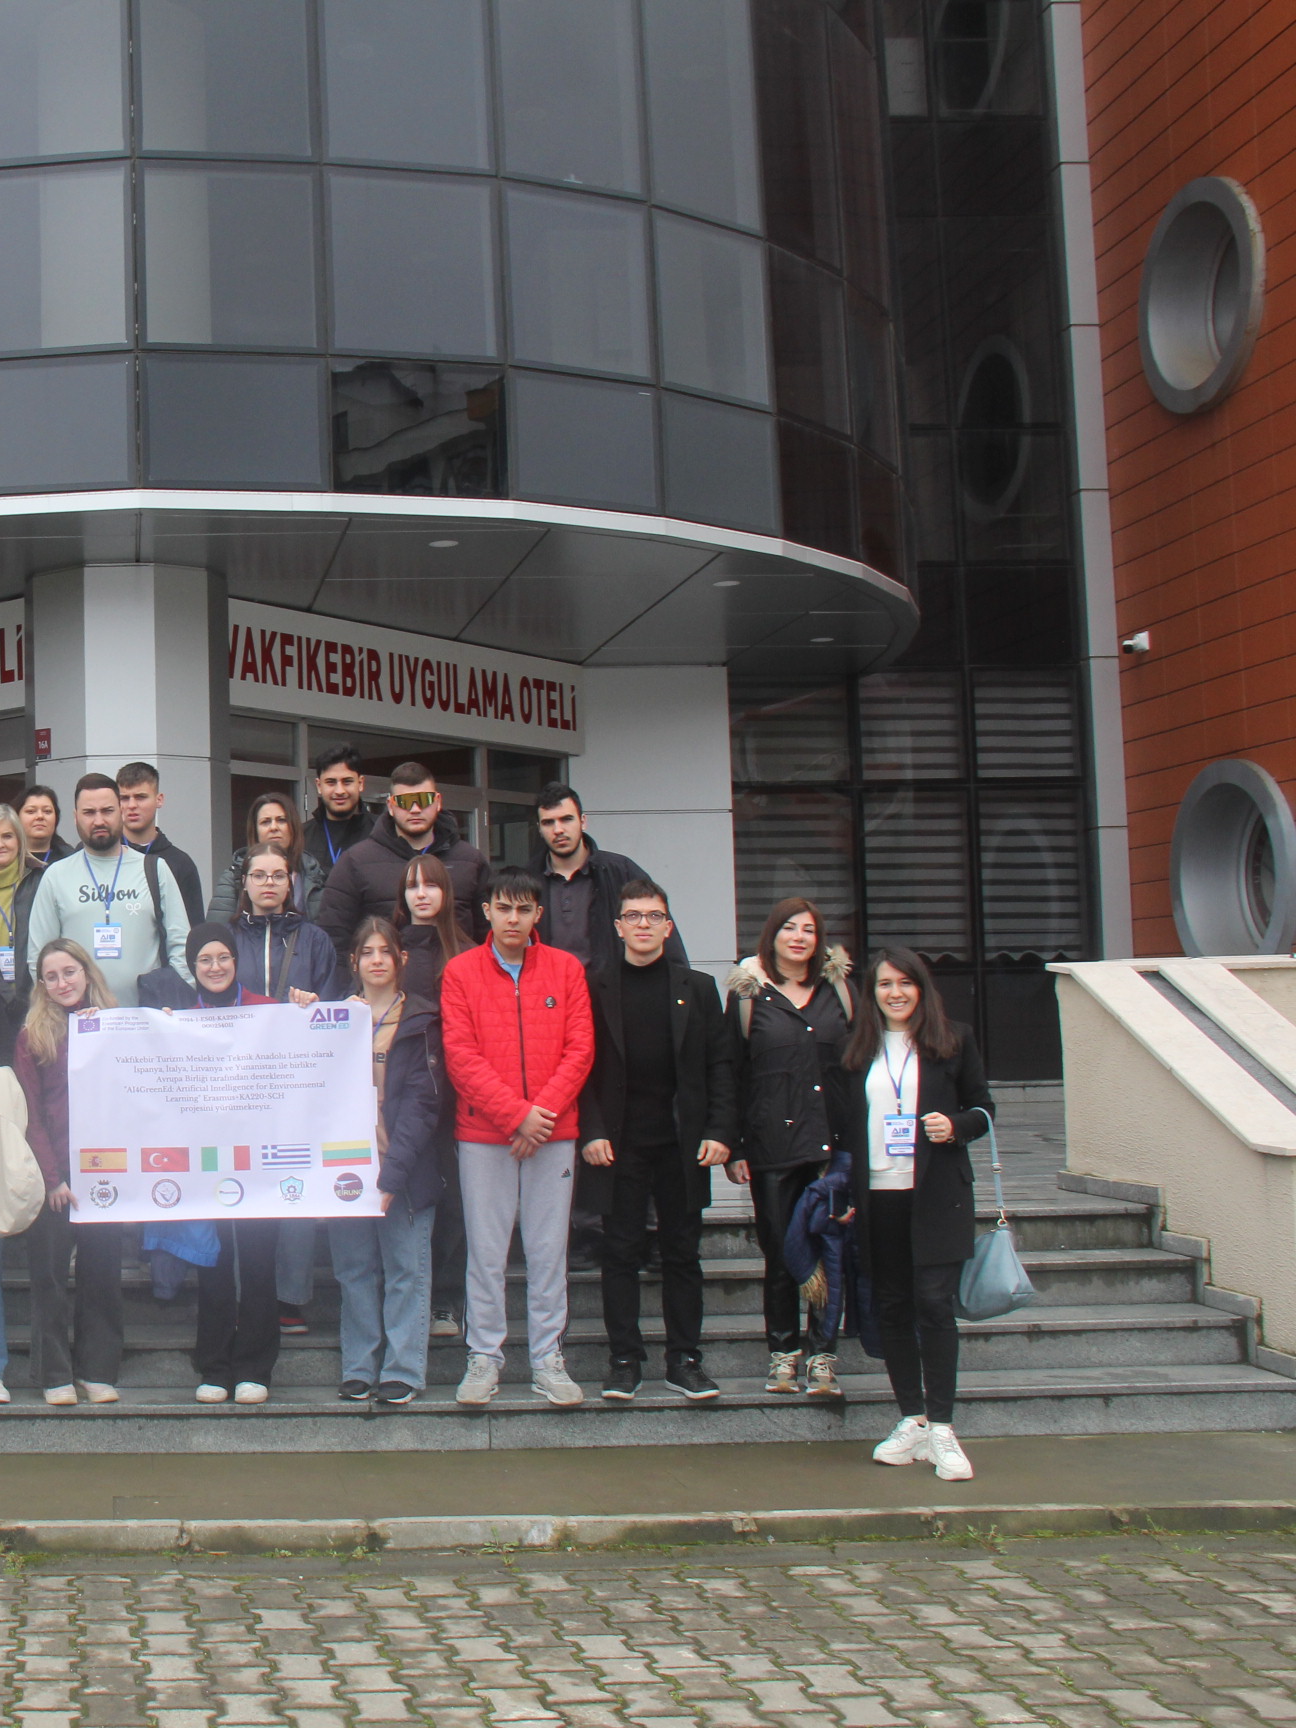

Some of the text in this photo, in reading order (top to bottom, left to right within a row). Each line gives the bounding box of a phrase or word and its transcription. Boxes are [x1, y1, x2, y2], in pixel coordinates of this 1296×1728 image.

[389, 652, 515, 722] UYGULAMA
[519, 676, 577, 732] OTELİ
[78, 884, 140, 903] Silbon
[156, 1055, 184, 1063] Turizm
[186, 1054, 214, 1062] Mesleki
[227, 1053, 253, 1061] Teknik
[255, 1052, 286, 1060] Anadolu
[288, 1051, 310, 1059] Lisesi
[311, 1050, 335, 1058] olarak
[190, 1064, 223, 1073] Litvanya
[235, 1063, 277, 1071] Yunanistan
[289, 1061, 317, 1069] birlikte
[156, 1075, 183, 1084] Avrupa
[176, 1084, 208, 1092] Artificial
[210, 1083, 254, 1092] Intelligence
[256, 1082, 268, 1090] for
[269, 1081, 325, 1089] Environmental
[180, 1105, 214, 1113] projesini
